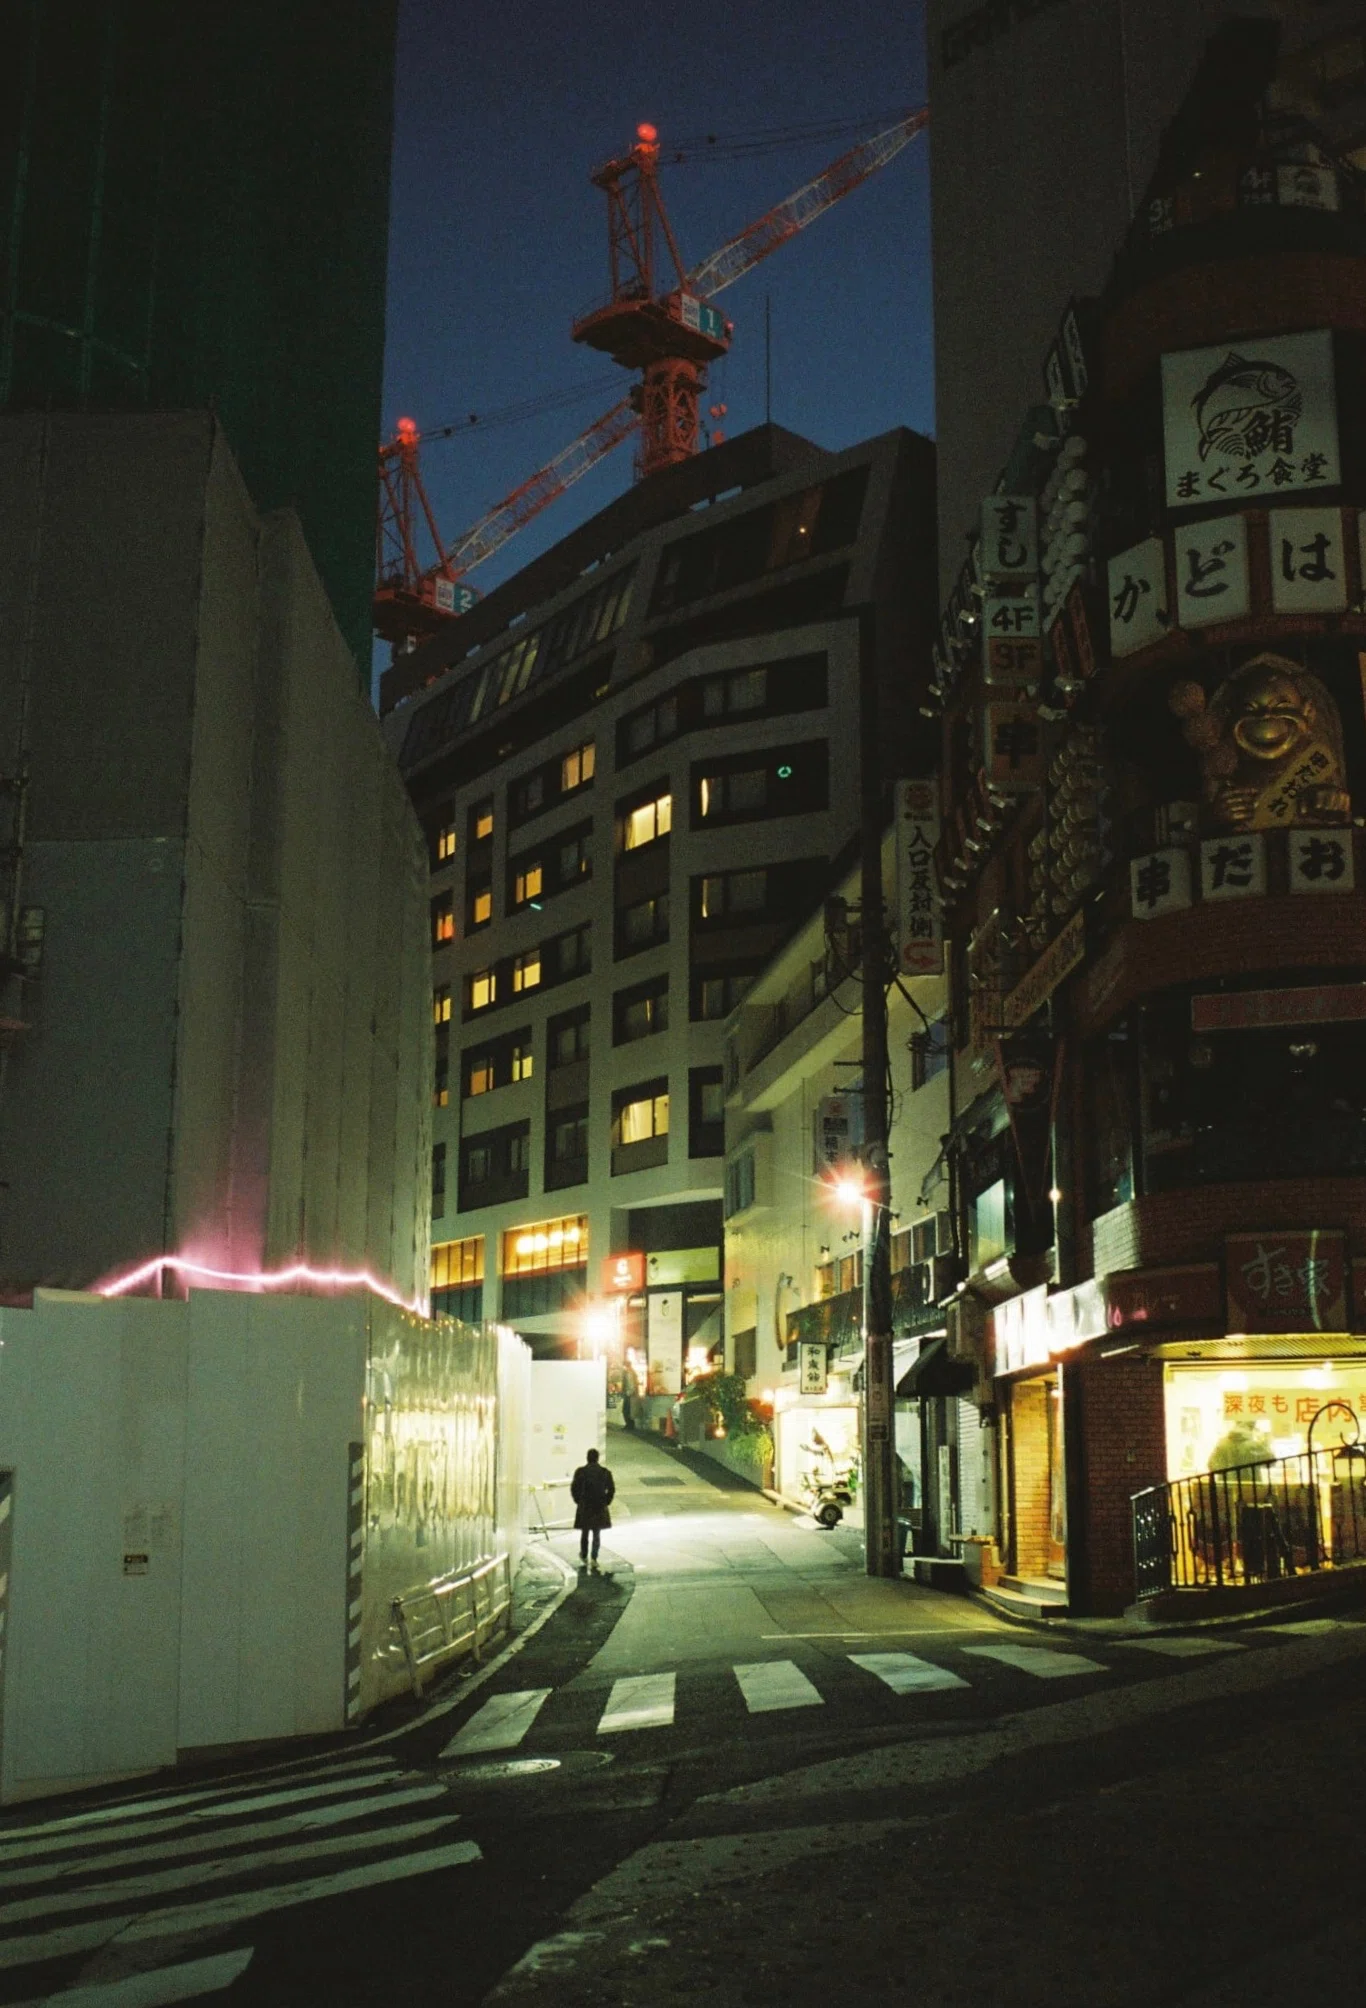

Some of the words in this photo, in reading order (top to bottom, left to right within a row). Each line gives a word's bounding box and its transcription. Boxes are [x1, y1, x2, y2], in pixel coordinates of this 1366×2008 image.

[706, 308, 714, 329] 1
[1242, 408, 1294, 460] 鮪
[1177, 452, 1328, 498] まぐろ食堂
[994, 500, 1028, 568] すし
[460, 589, 473, 609] 2
[991, 605, 1034, 632] 4F
[996, 643, 1035, 671] 3F
[995, 721, 1038, 768] 串
[909, 825, 933, 938] 入口反対側
[1241, 1243, 1331, 1300] すき家
